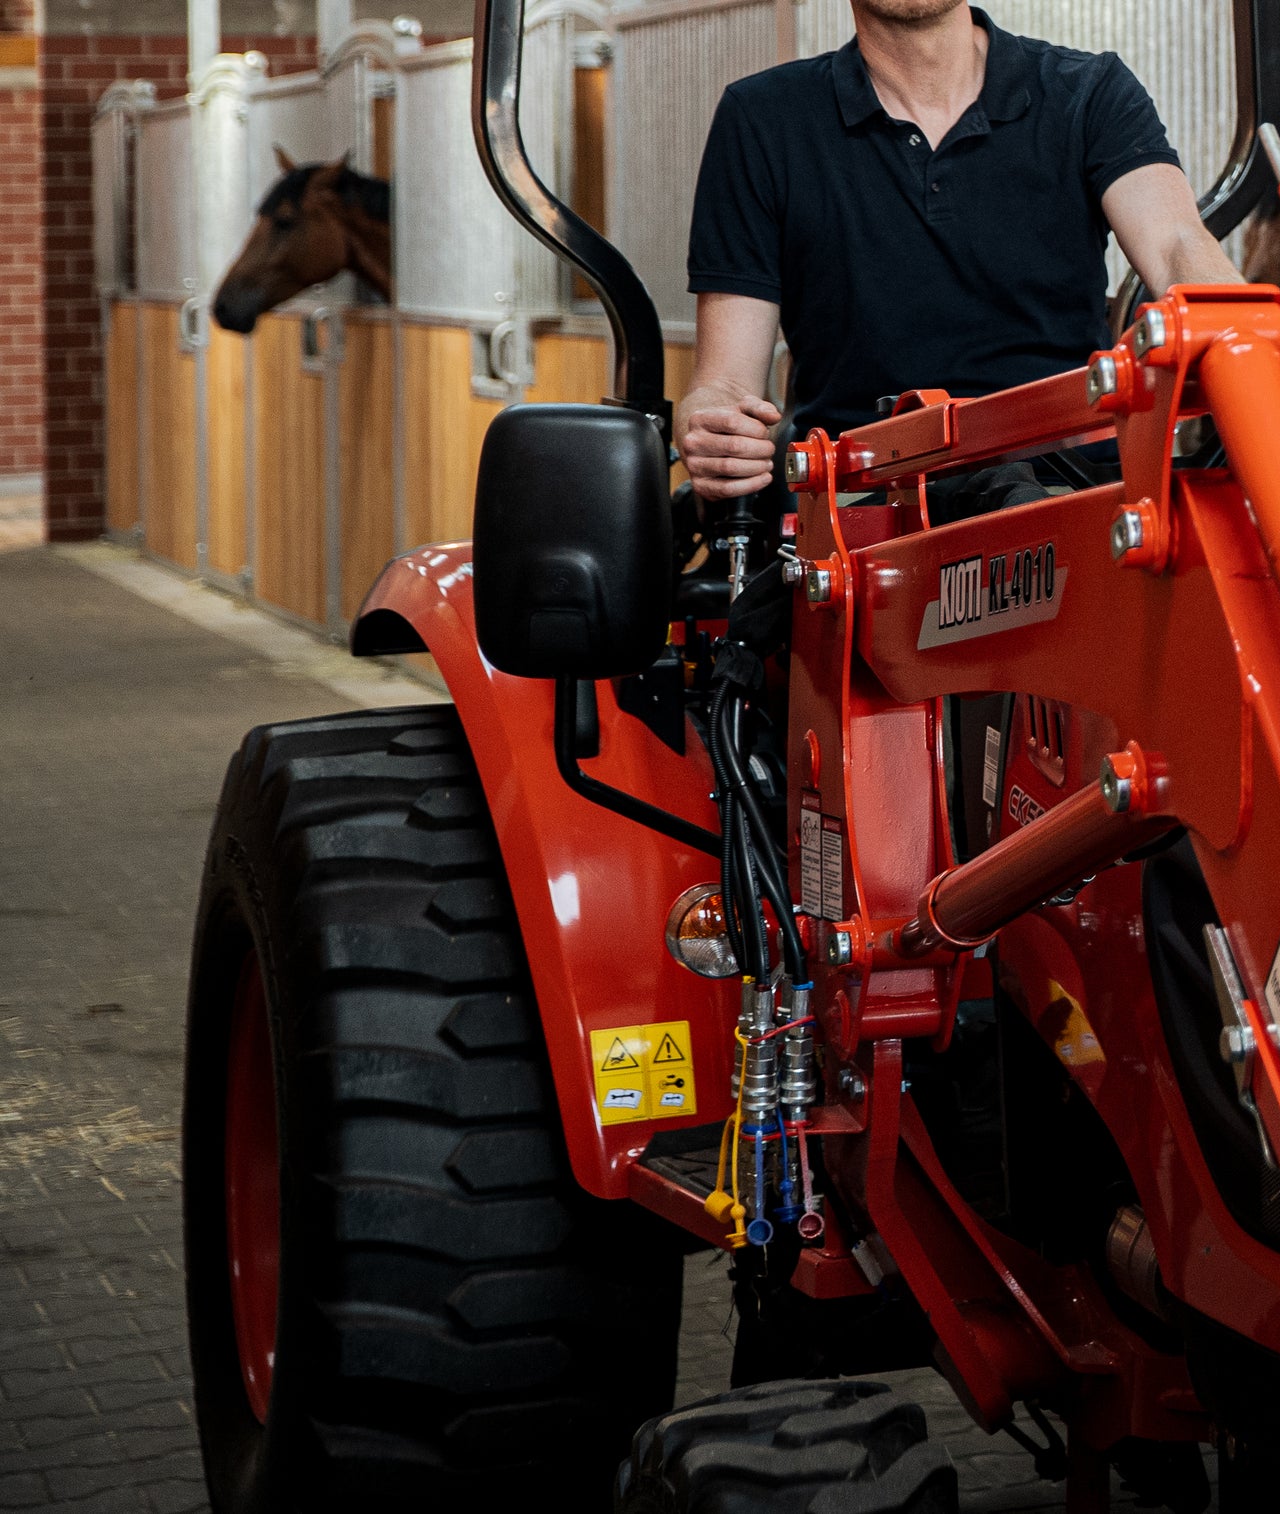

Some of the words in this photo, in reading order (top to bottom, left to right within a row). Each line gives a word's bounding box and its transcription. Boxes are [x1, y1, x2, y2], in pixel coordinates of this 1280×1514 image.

[939, 554, 982, 629] KIOTI
[988, 542, 1055, 616] KL4010
[1009, 784, 1046, 826] CK5
